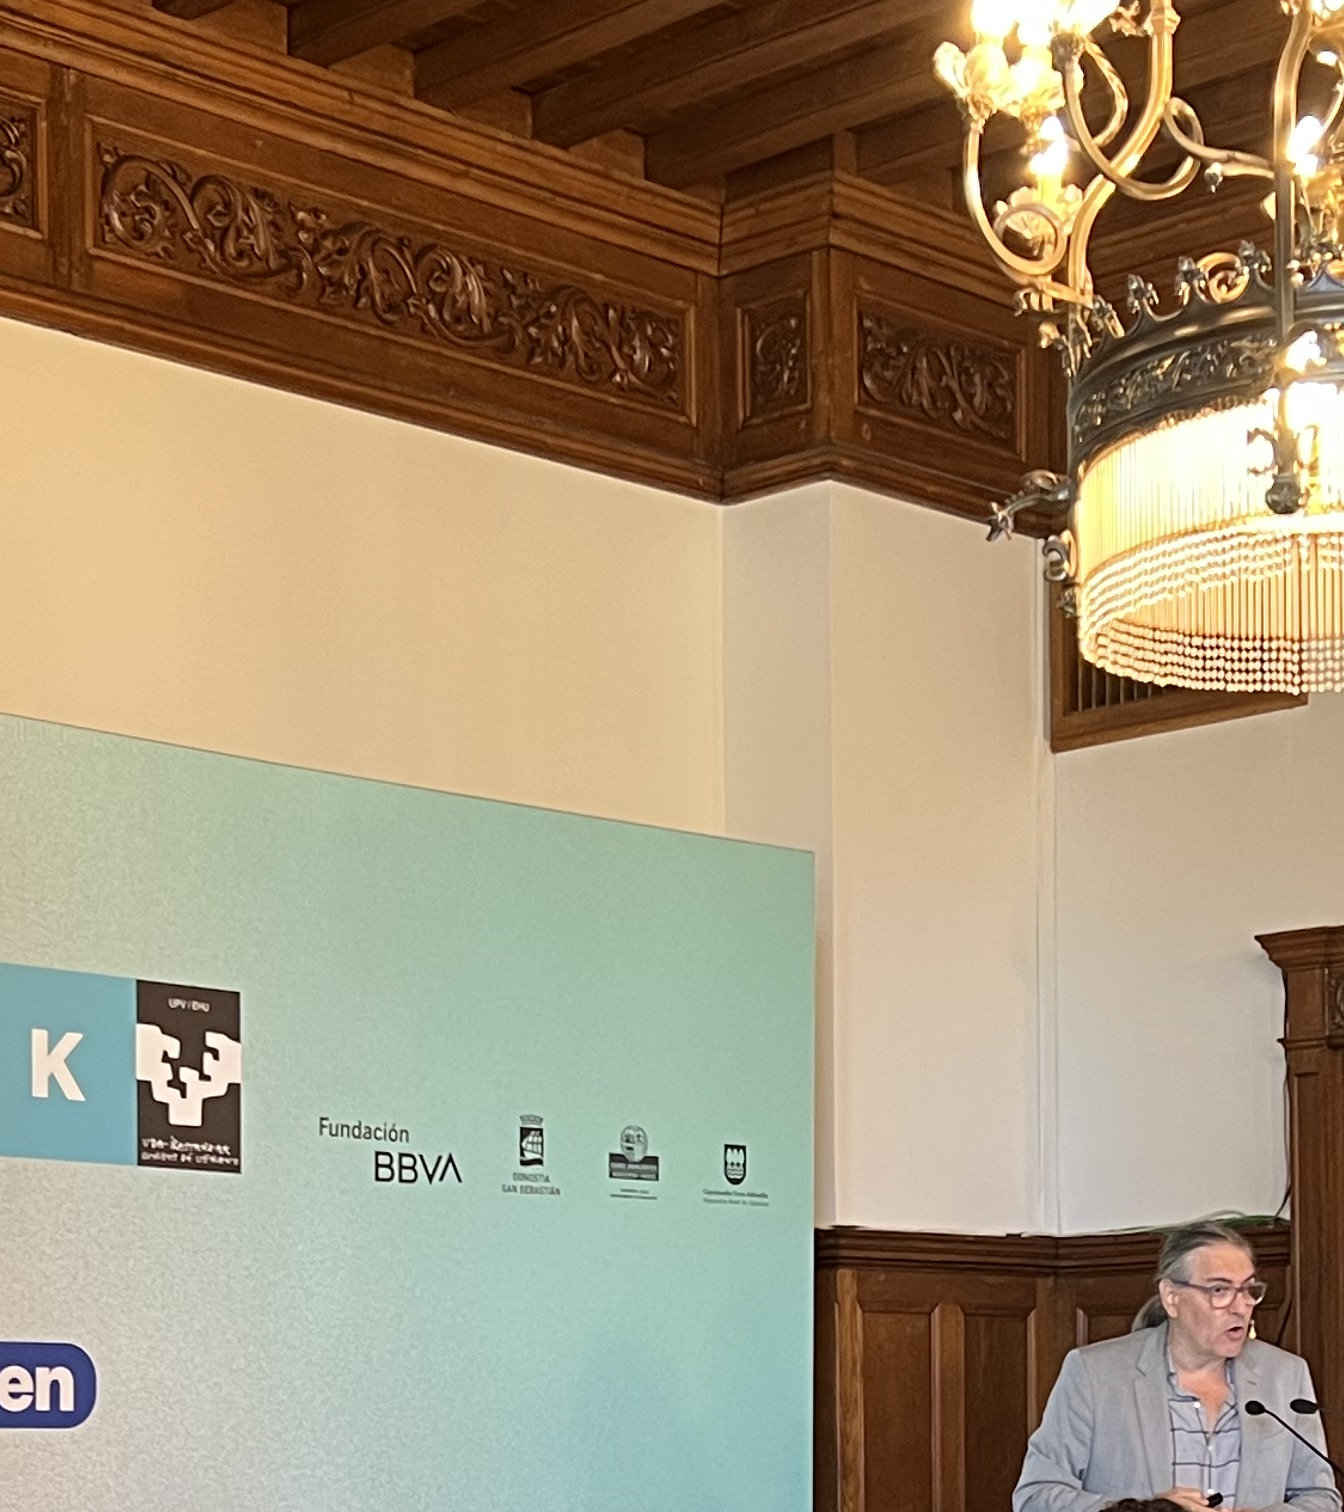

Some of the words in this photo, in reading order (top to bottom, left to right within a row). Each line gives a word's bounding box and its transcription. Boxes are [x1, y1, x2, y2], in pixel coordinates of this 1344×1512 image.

[30, 1028, 86, 1102] K
[318, 1117, 411, 1144] Fundación
[374, 1150, 463, 1185] BBVA
